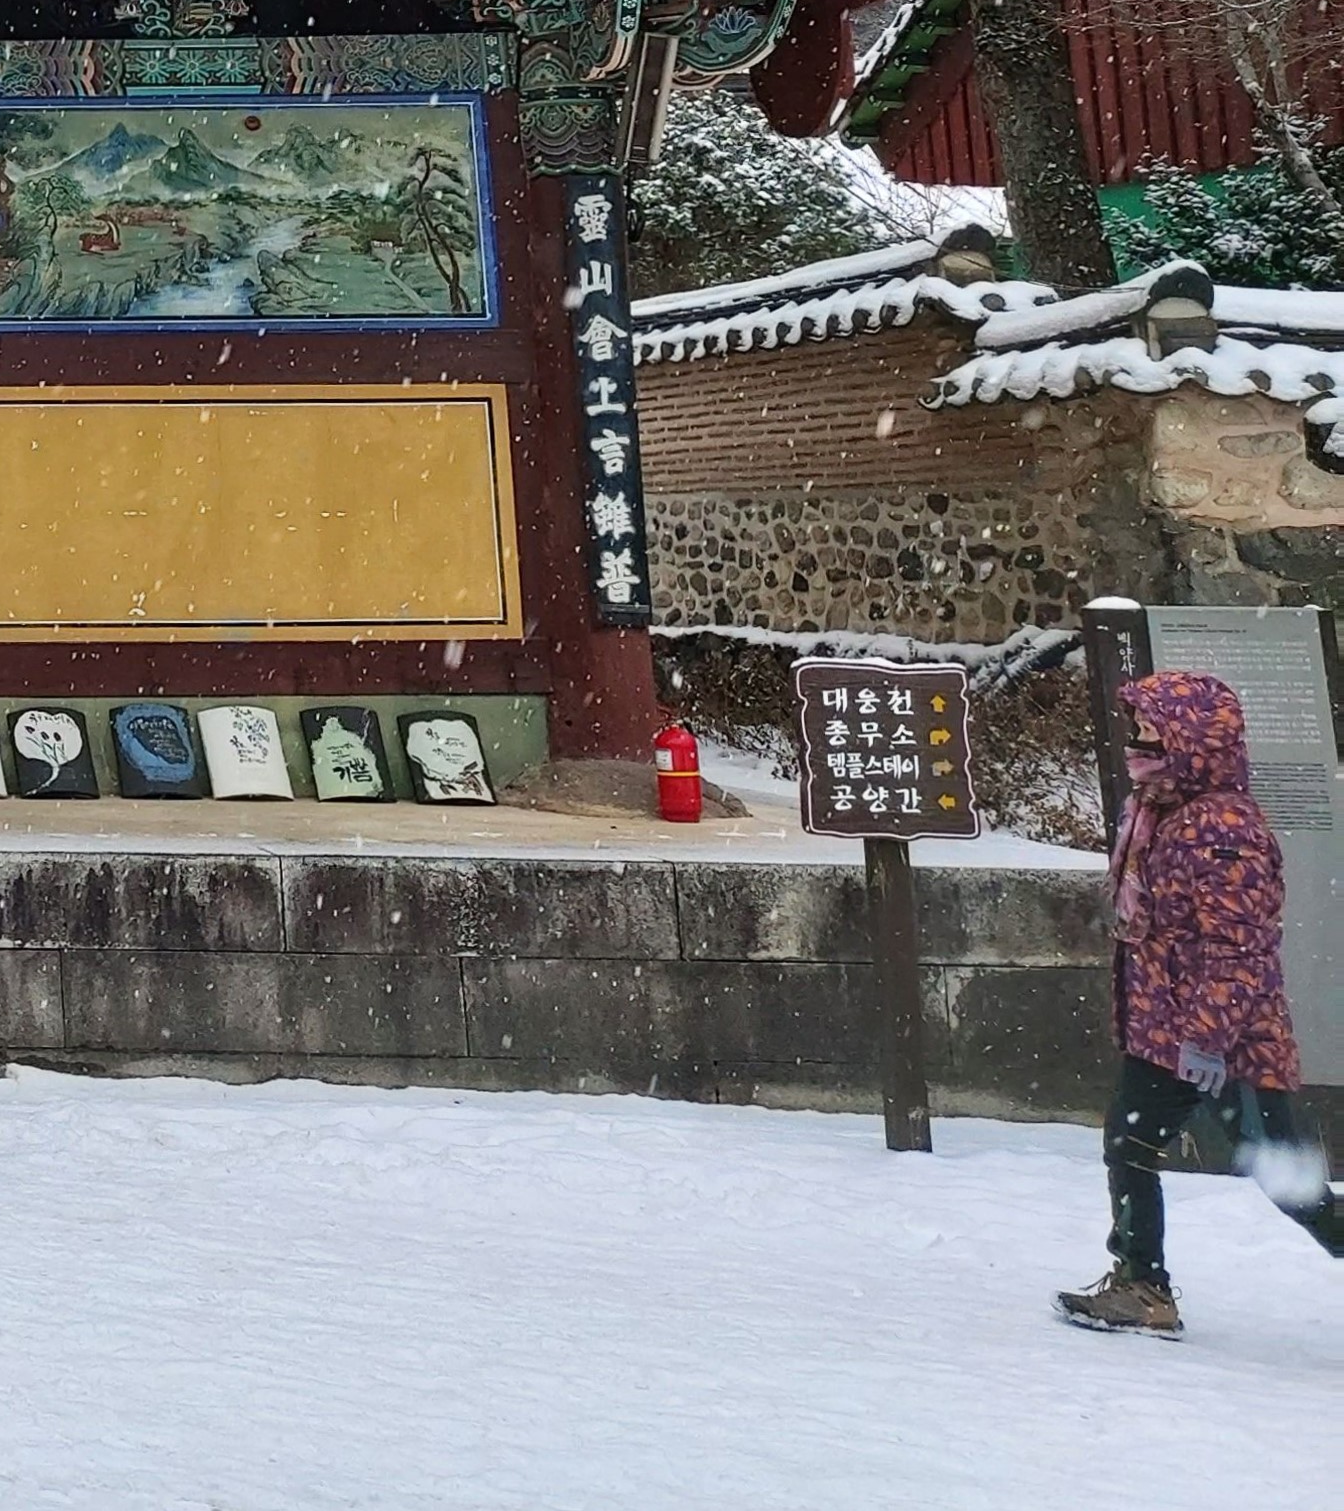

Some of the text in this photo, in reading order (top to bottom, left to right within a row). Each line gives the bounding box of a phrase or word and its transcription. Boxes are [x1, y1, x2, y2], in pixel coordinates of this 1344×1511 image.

[822, 687, 915, 715] 대웅전
[824, 719, 918, 748] 종무소
[332, 757, 374, 783] 기쁨
[827, 751, 920, 780] 템플스테이
[829, 784, 923, 814] 공양간
